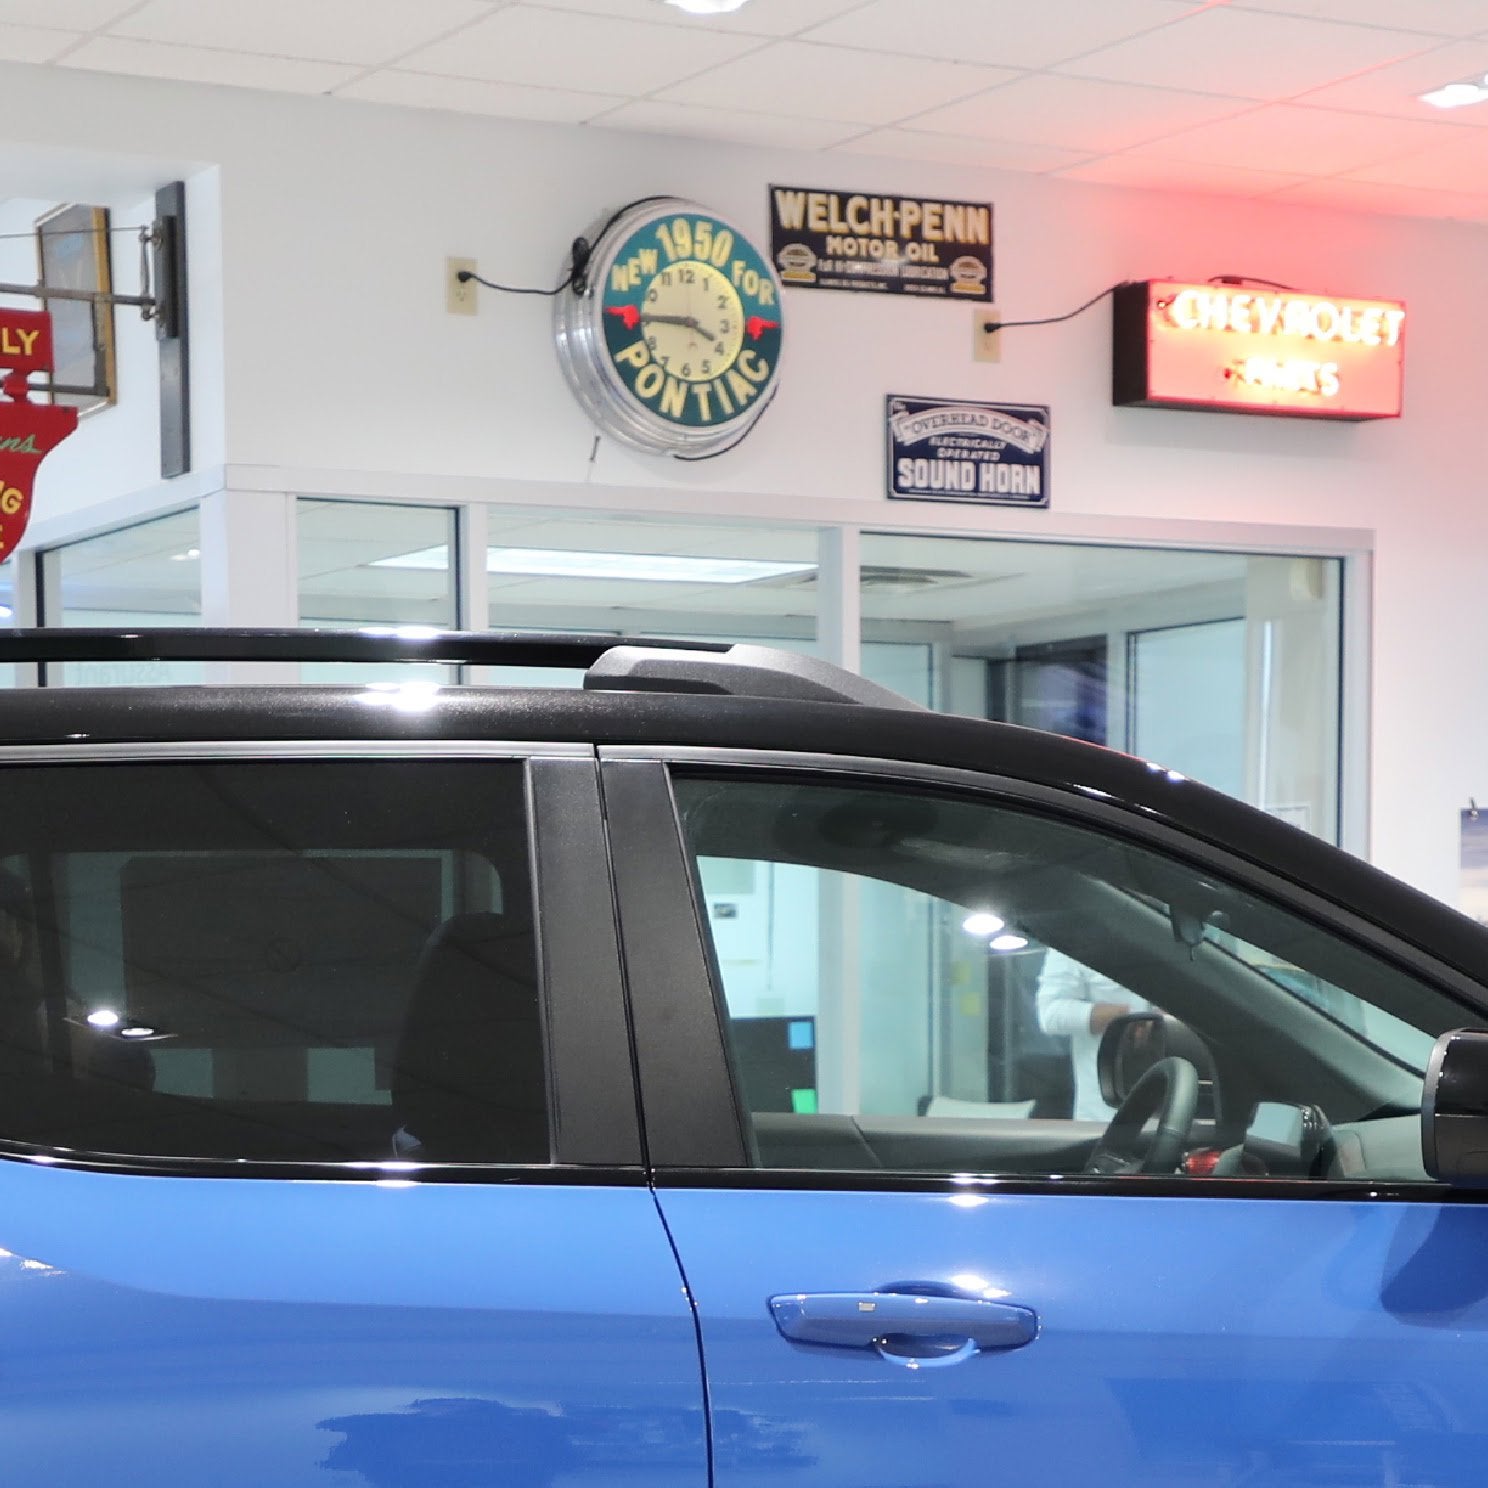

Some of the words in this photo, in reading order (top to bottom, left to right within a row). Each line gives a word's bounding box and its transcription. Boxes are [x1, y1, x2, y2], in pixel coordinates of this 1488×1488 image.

[774, 189, 990, 245] WELCH-PENN
[612, 249, 659, 292] NEW
[655, 217, 734, 268] 1950
[731, 260, 775, 306] FOR
[825, 235, 899, 259] MOTOR
[904, 242, 940, 263] OIL
[679, 269, 696, 285] 12
[718, 295, 729, 309] 2
[1172, 288, 1405, 347] CHEVROLET
[720, 319, 730, 334] 3
[715, 342, 725, 356] 4
[613, 339, 769, 421] PONTIAC
[897, 457, 977, 491] SOUND
[978, 462, 1042, 495] HORN
